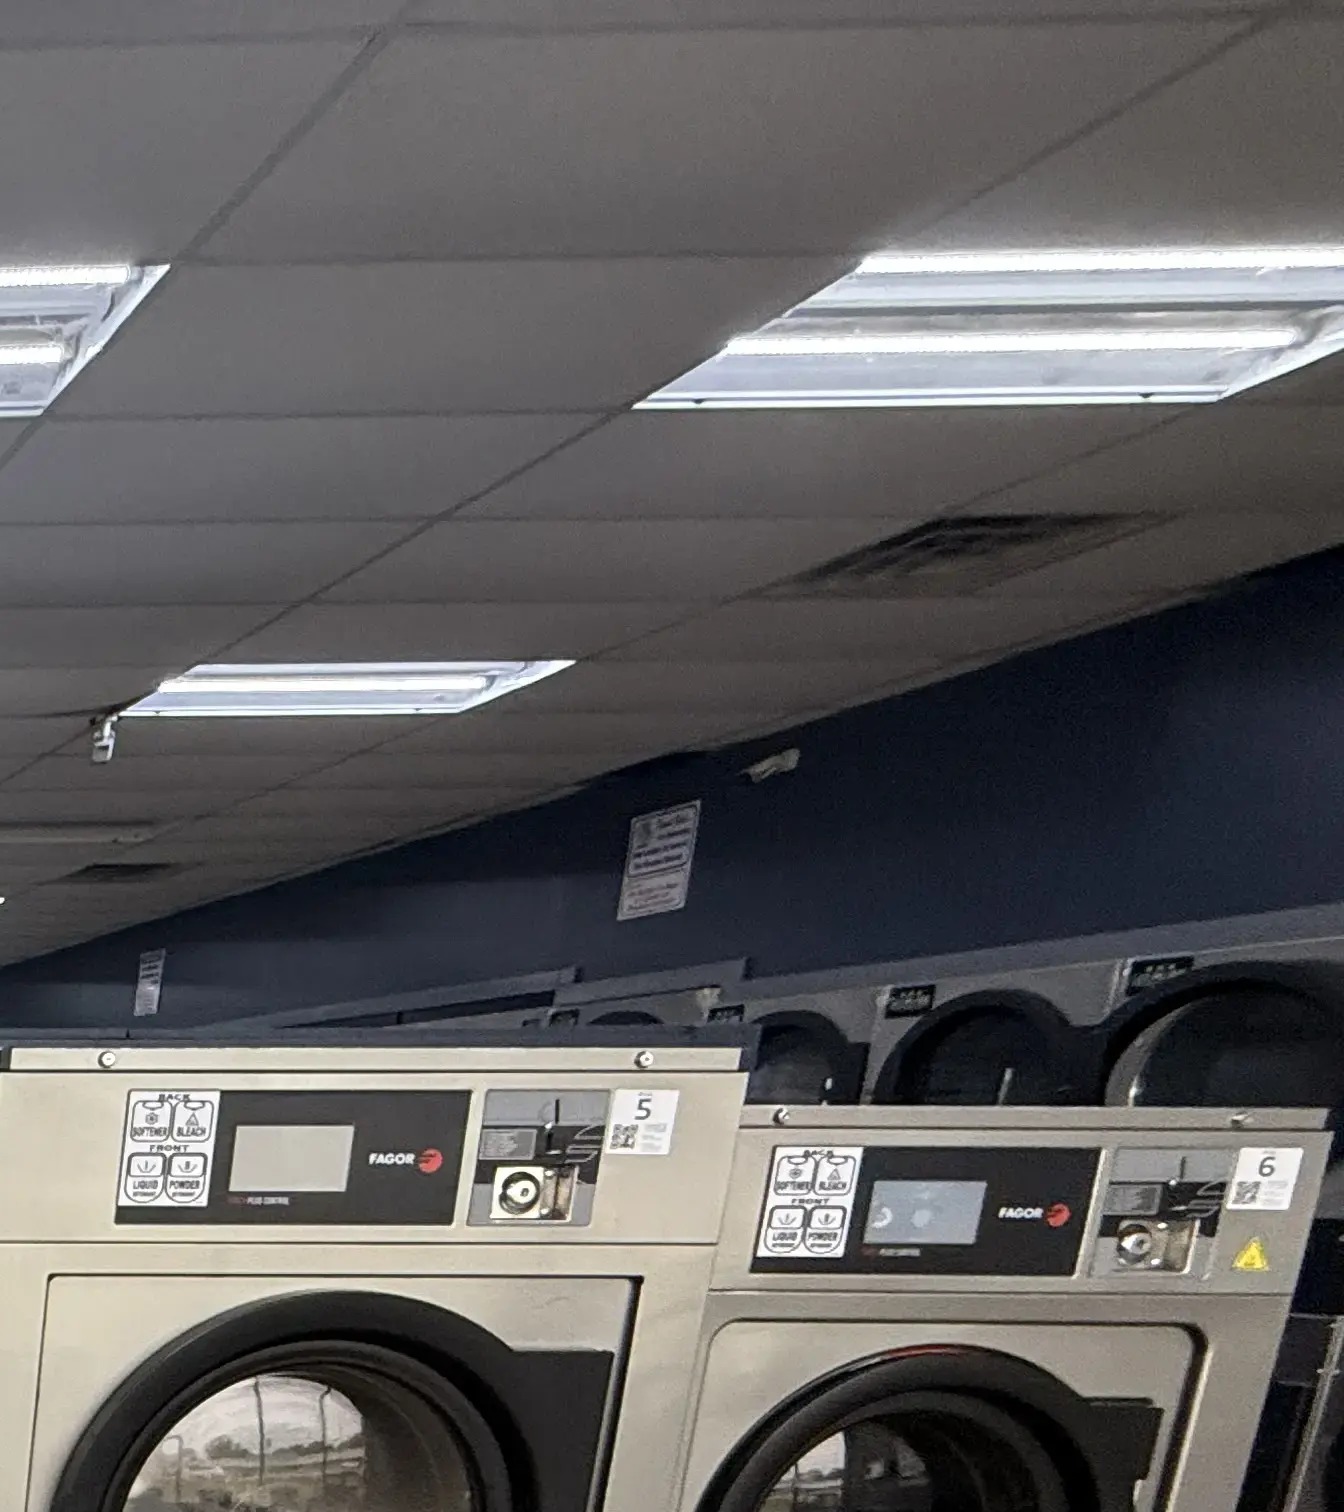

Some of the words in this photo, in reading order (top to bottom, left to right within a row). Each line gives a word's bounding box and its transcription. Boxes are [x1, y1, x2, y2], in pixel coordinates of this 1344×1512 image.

[634, 1098, 652, 1120] 5
[132, 1127, 168, 1137] SOFTENER
[176, 1127, 206, 1137] BLEACH
[368, 1152, 415, 1165] FAGOR
[1258, 1156, 1275, 1177] 6
[133, 1180, 158, 1190] LIQUID
[169, 1180, 200, 1190] POWDER
[998, 1206, 1043, 1219] FAGOR
